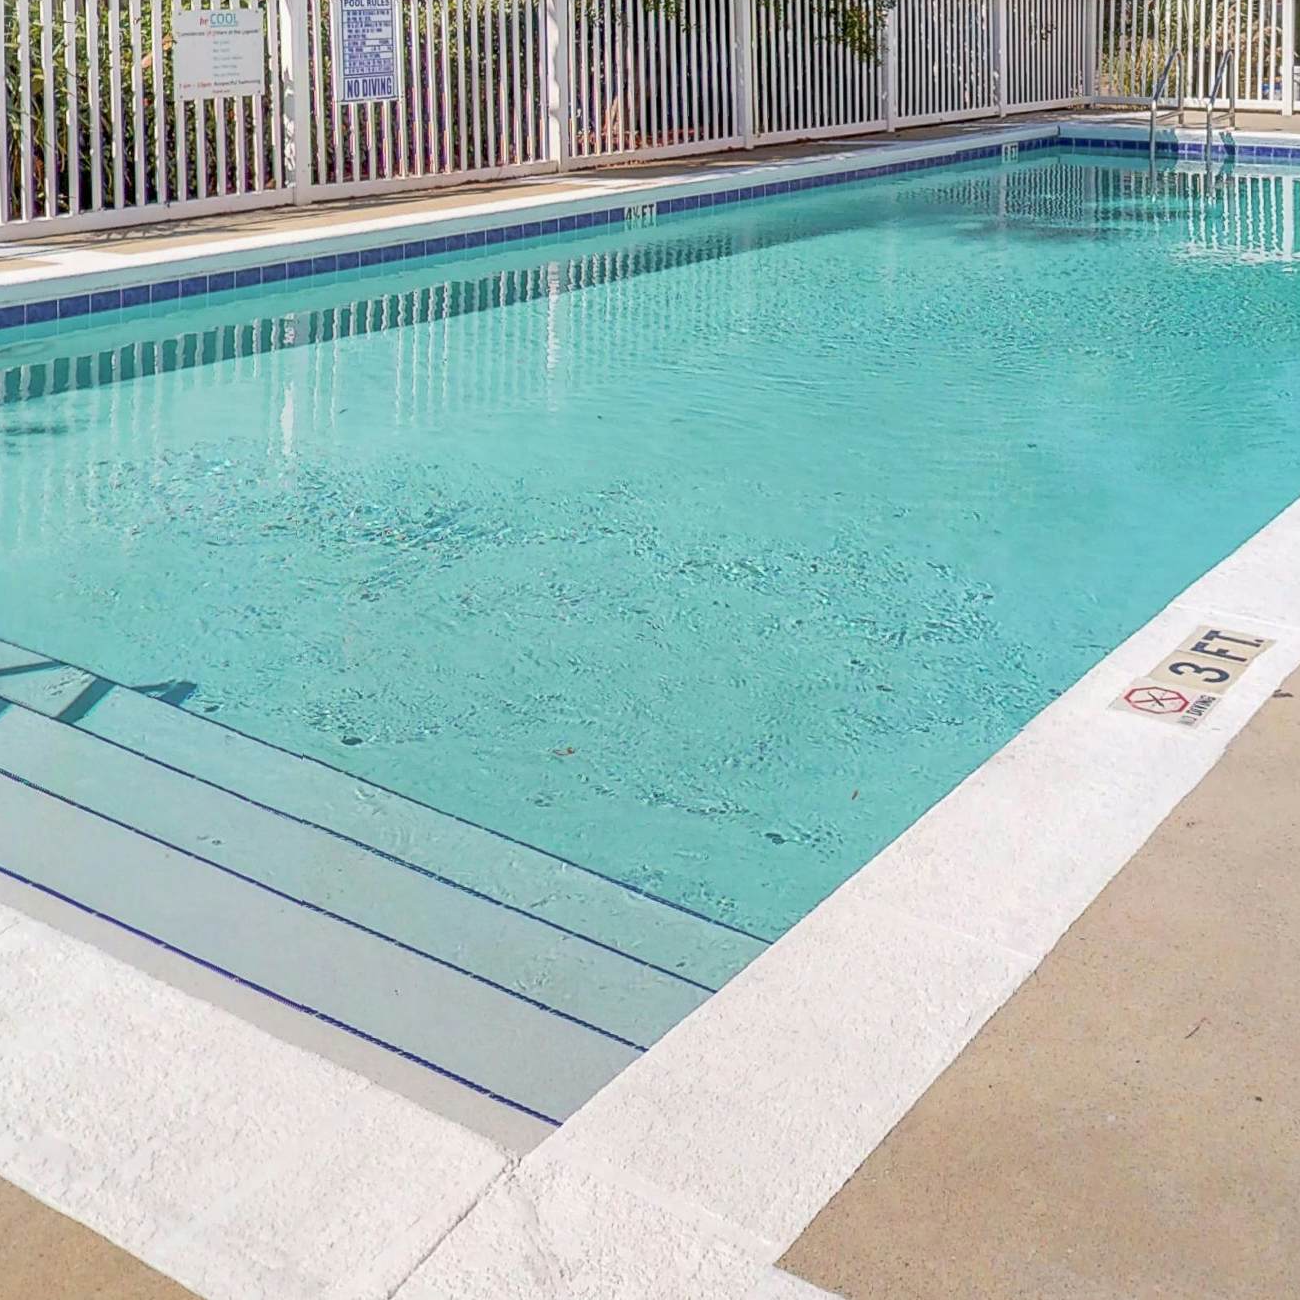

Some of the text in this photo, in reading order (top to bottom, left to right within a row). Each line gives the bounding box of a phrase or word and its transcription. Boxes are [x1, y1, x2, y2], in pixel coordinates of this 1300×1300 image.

[210, 13, 239, 26] COOL
[347, 76, 392, 99] NO DIVING
[1168, 661, 1230, 683] 3
[1185, 694, 1217, 717] DIVING
